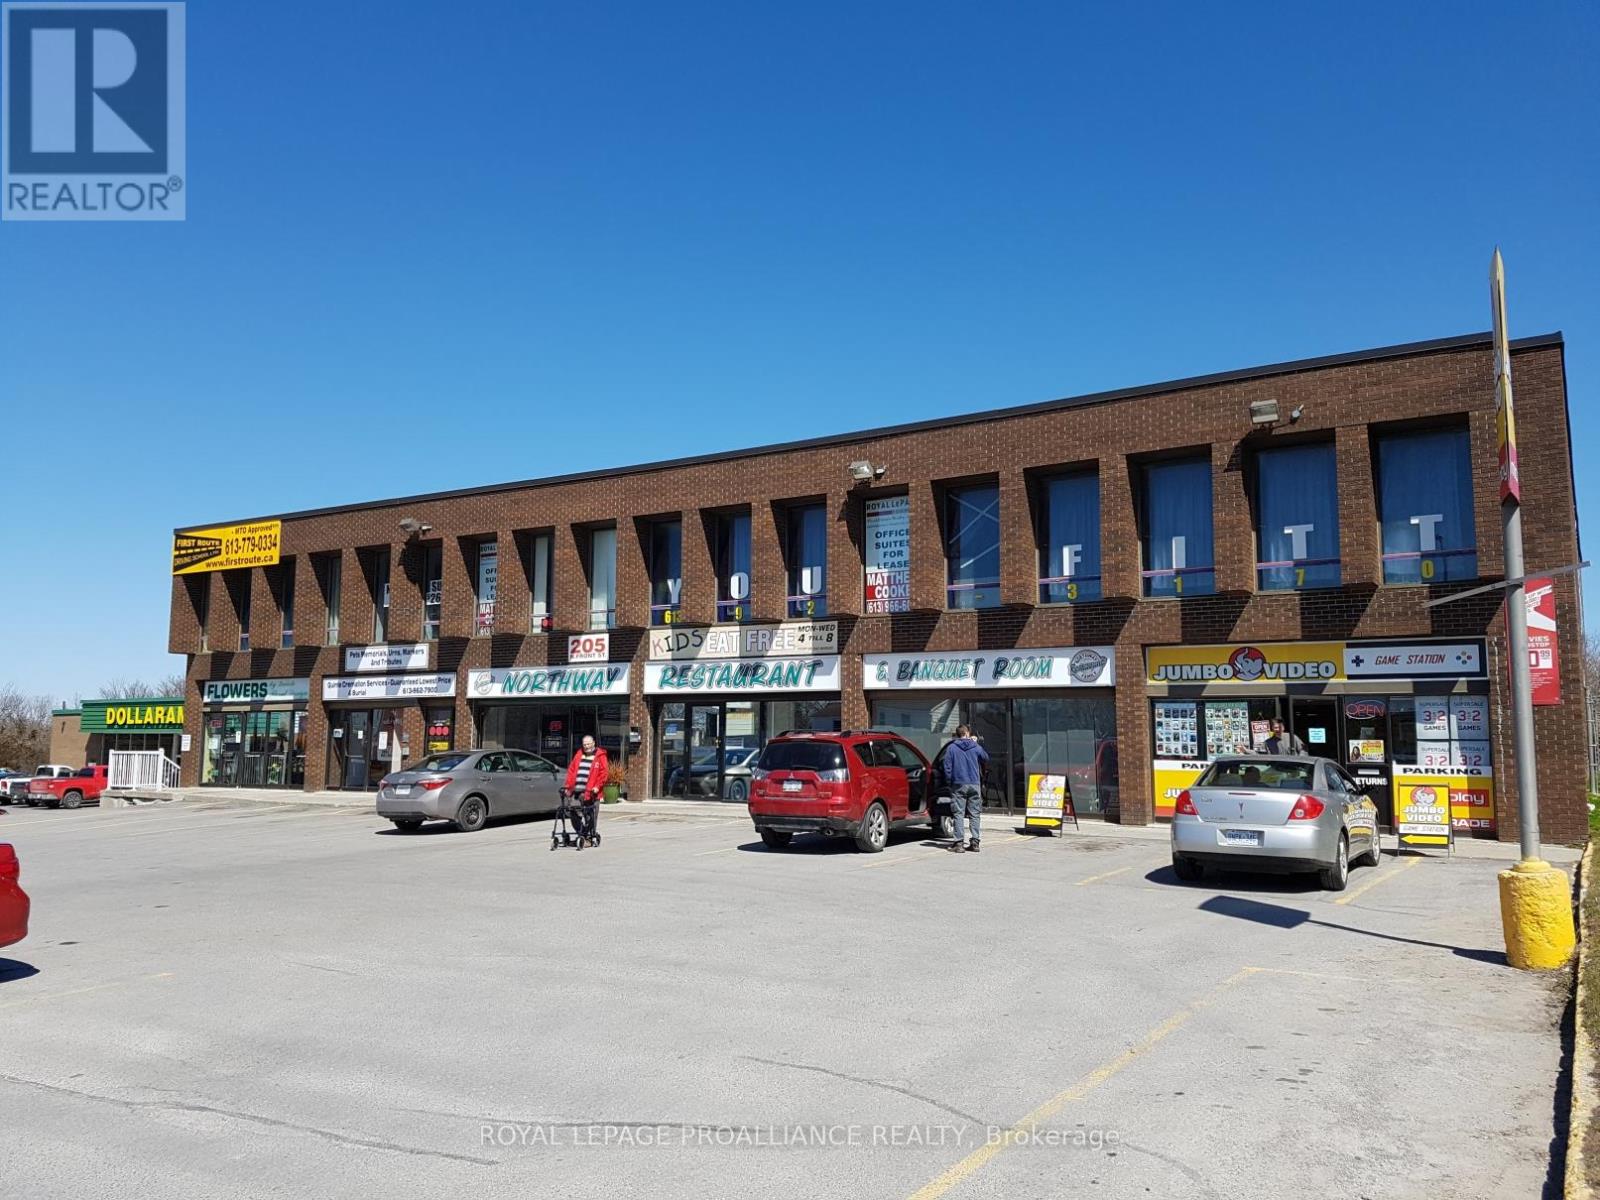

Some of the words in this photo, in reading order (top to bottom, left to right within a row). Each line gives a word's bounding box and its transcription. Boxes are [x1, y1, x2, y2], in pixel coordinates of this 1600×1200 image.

[866, 500, 890, 511] ROYAL
[235, 526, 247, 534] MTO
[248, 525, 272, 534] Approved
[176, 539, 196, 547] FIRST
[225, 534, 278, 555] 613-779-0334
[1062, 544, 1082, 576] F
[1284, 524, 1314, 559] T
[1410, 514, 1443, 551] T
[883, 550, 904, 559] FOR
[205, 554, 274, 569] www.firstroute.ca
[877, 561, 909, 570] LEASE
[730, 572, 749, 600] O
[802, 566, 822, 594] U
[867, 571, 910, 586] MATTHE
[1067, 583, 1078, 599] 3
[1174, 576, 1184, 593] 1
[1296, 569, 1304, 586] 7
[807, 601, 815, 615] 2
[866, 601, 884, 614] (613)
[798, 624, 836, 632] MON-WED
[652, 629, 704, 657] KIDS
[706, 630, 741, 654] EAT
[745, 627, 796, 652] FREE
[798, 633, 805, 643] 4
[826, 632, 834, 643] 8
[403, 648, 424, 656] Markers
[570, 638, 606, 654] 205
[1375, 655, 1400, 665] GAME
[1406, 654, 1446, 665] STATION
[876, 660, 889, 681] &
[896, 658, 985, 682] BANQUET
[992, 655, 1054, 680] ROOM
[1153, 664, 1234, 681] JUMBO
[1263, 661, 1336, 678] VIDEO
[502, 667, 621, 695] NORTHWAY
[659, 660, 824, 690] RESTAURANT
[342, 680, 366, 688] Cremation
[367, 679, 387, 687] Services
[437, 676, 451, 684] Price
[207, 682, 268, 699] FLOWERS
[1346, 703, 1386, 716] OPEN
[1458, 710, 1467, 721] 3
[1471, 710, 1481, 721] 2
[1423, 710, 1432, 722] 3
[1435, 710, 1446, 721] 2
[1425, 755, 1434, 766] 3
[1437, 755, 1447, 766] 2
[1459, 755, 1468, 766] 3
[1472, 755, 1481, 766] 2
[1402, 767, 1482, 775] PARKING
[1404, 805, 1445, 814] JUMBO
[1406, 814, 1442, 822] VIDEO
